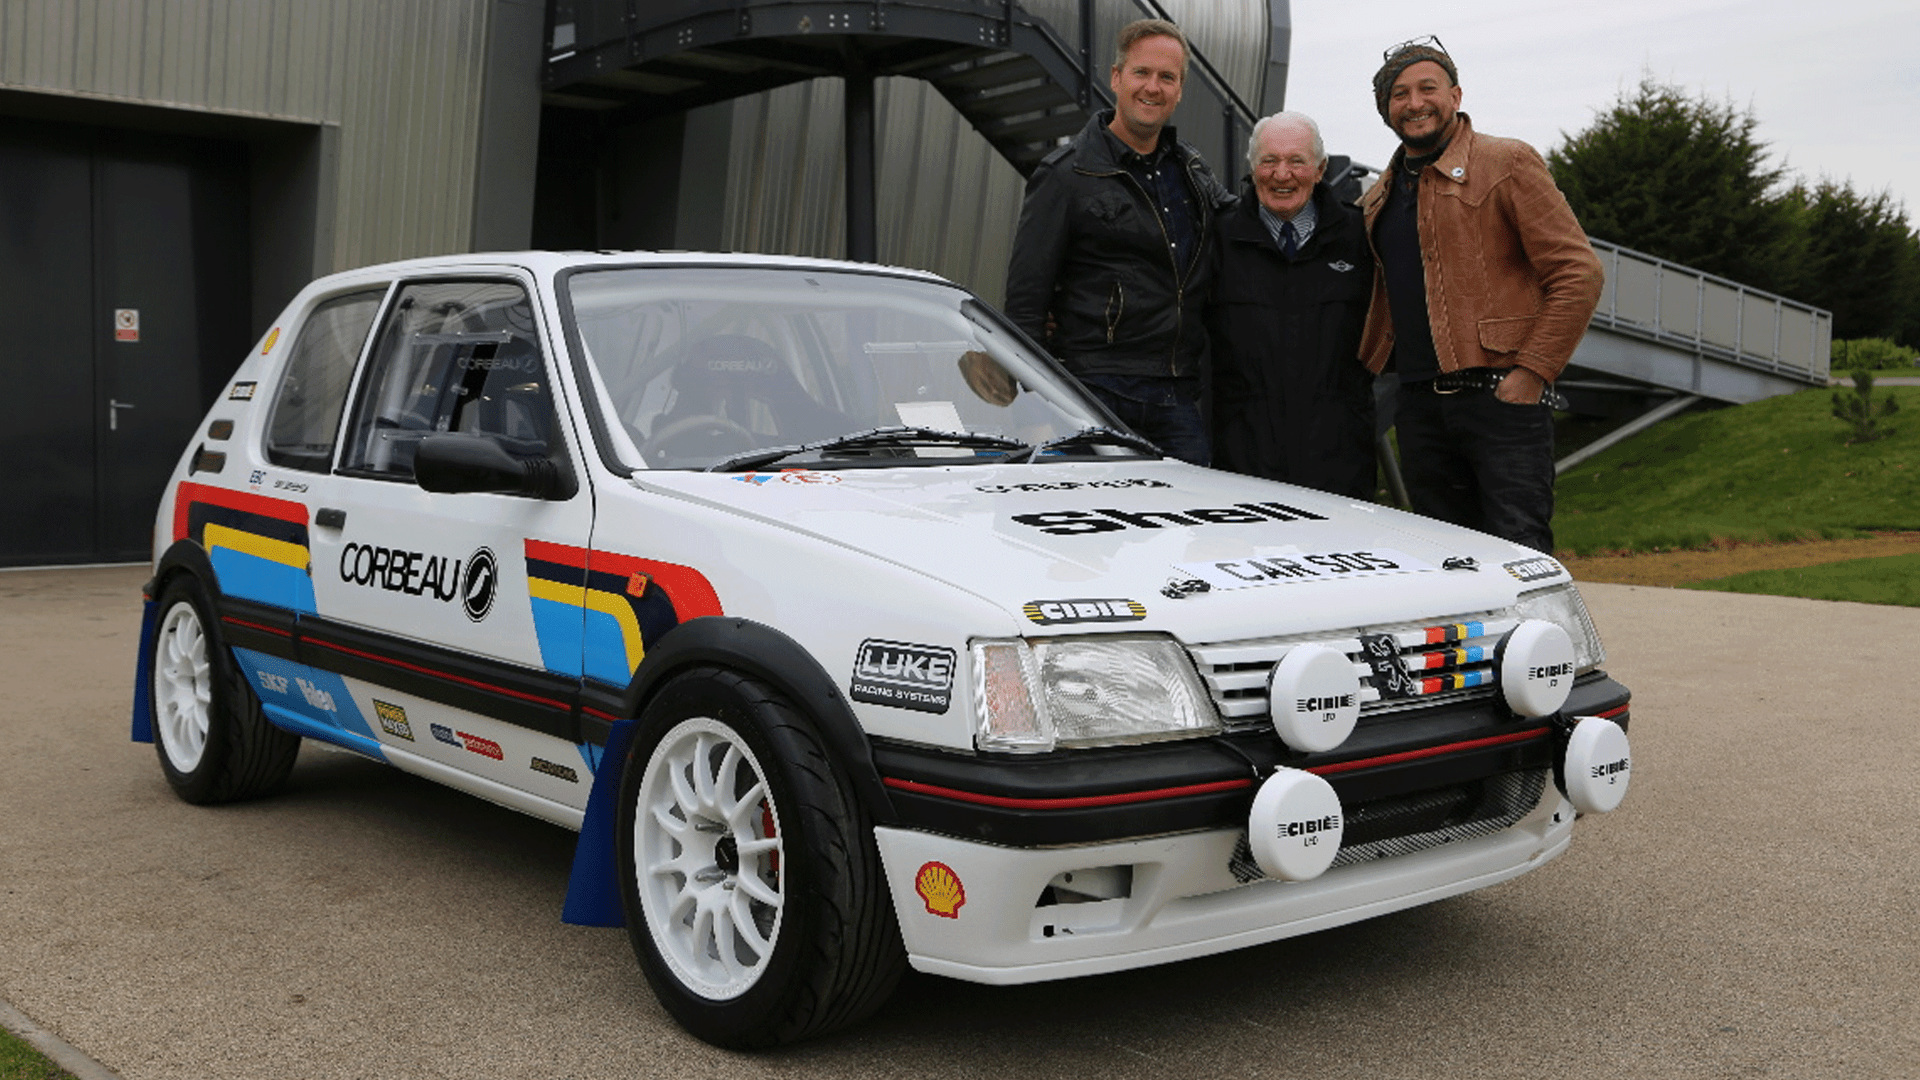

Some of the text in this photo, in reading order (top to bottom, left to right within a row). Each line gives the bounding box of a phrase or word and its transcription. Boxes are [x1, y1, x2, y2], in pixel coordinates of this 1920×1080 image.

[457, 357, 521, 370] CORBEAU
[707, 360, 762, 372] CORBEAU
[1011, 502, 1330, 535] Shell
[340, 542, 462, 603] CORBEAU
[1214, 551, 1400, 582] CAR SOS
[861, 648, 950, 684] LUKE
[854, 683, 947, 706] RACING SYSTEMS
